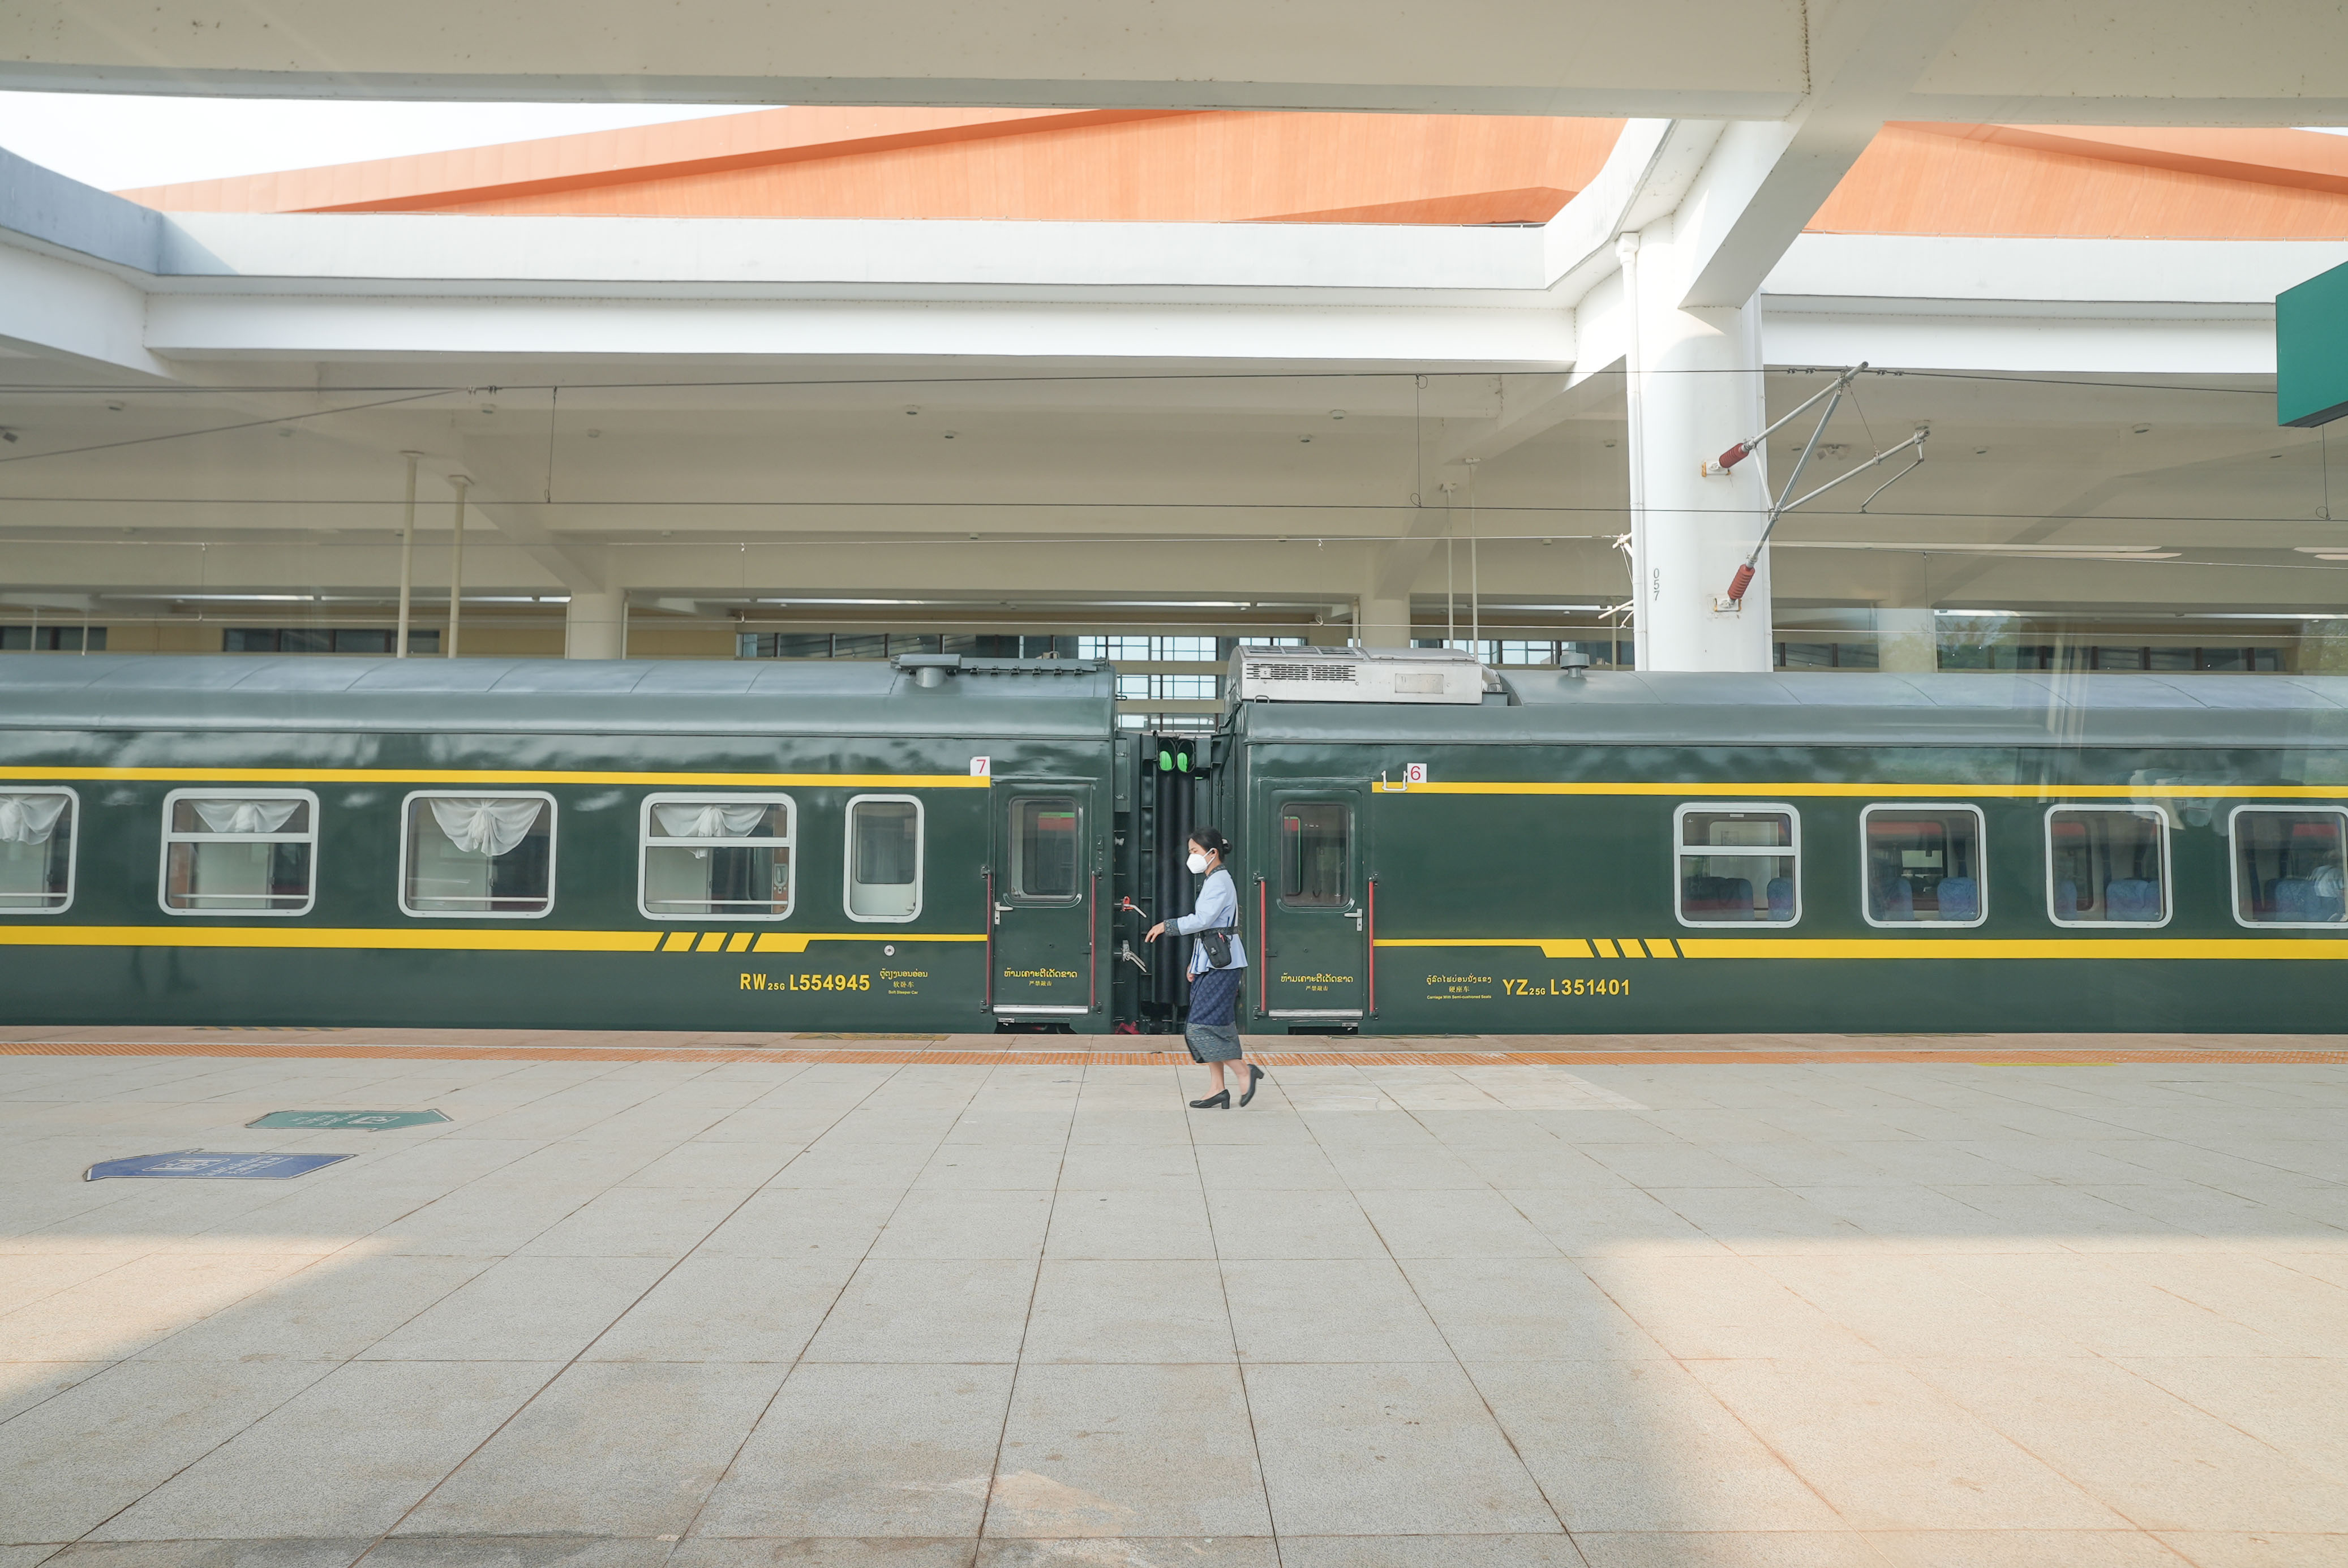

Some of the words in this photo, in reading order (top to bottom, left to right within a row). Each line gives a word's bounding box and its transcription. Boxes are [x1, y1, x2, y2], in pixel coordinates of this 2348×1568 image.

[976, 759, 986, 774] 7
[1410, 766, 1421, 780] 6
[789, 974, 870, 991] L554945
[1551, 979, 1630, 995] L351401
